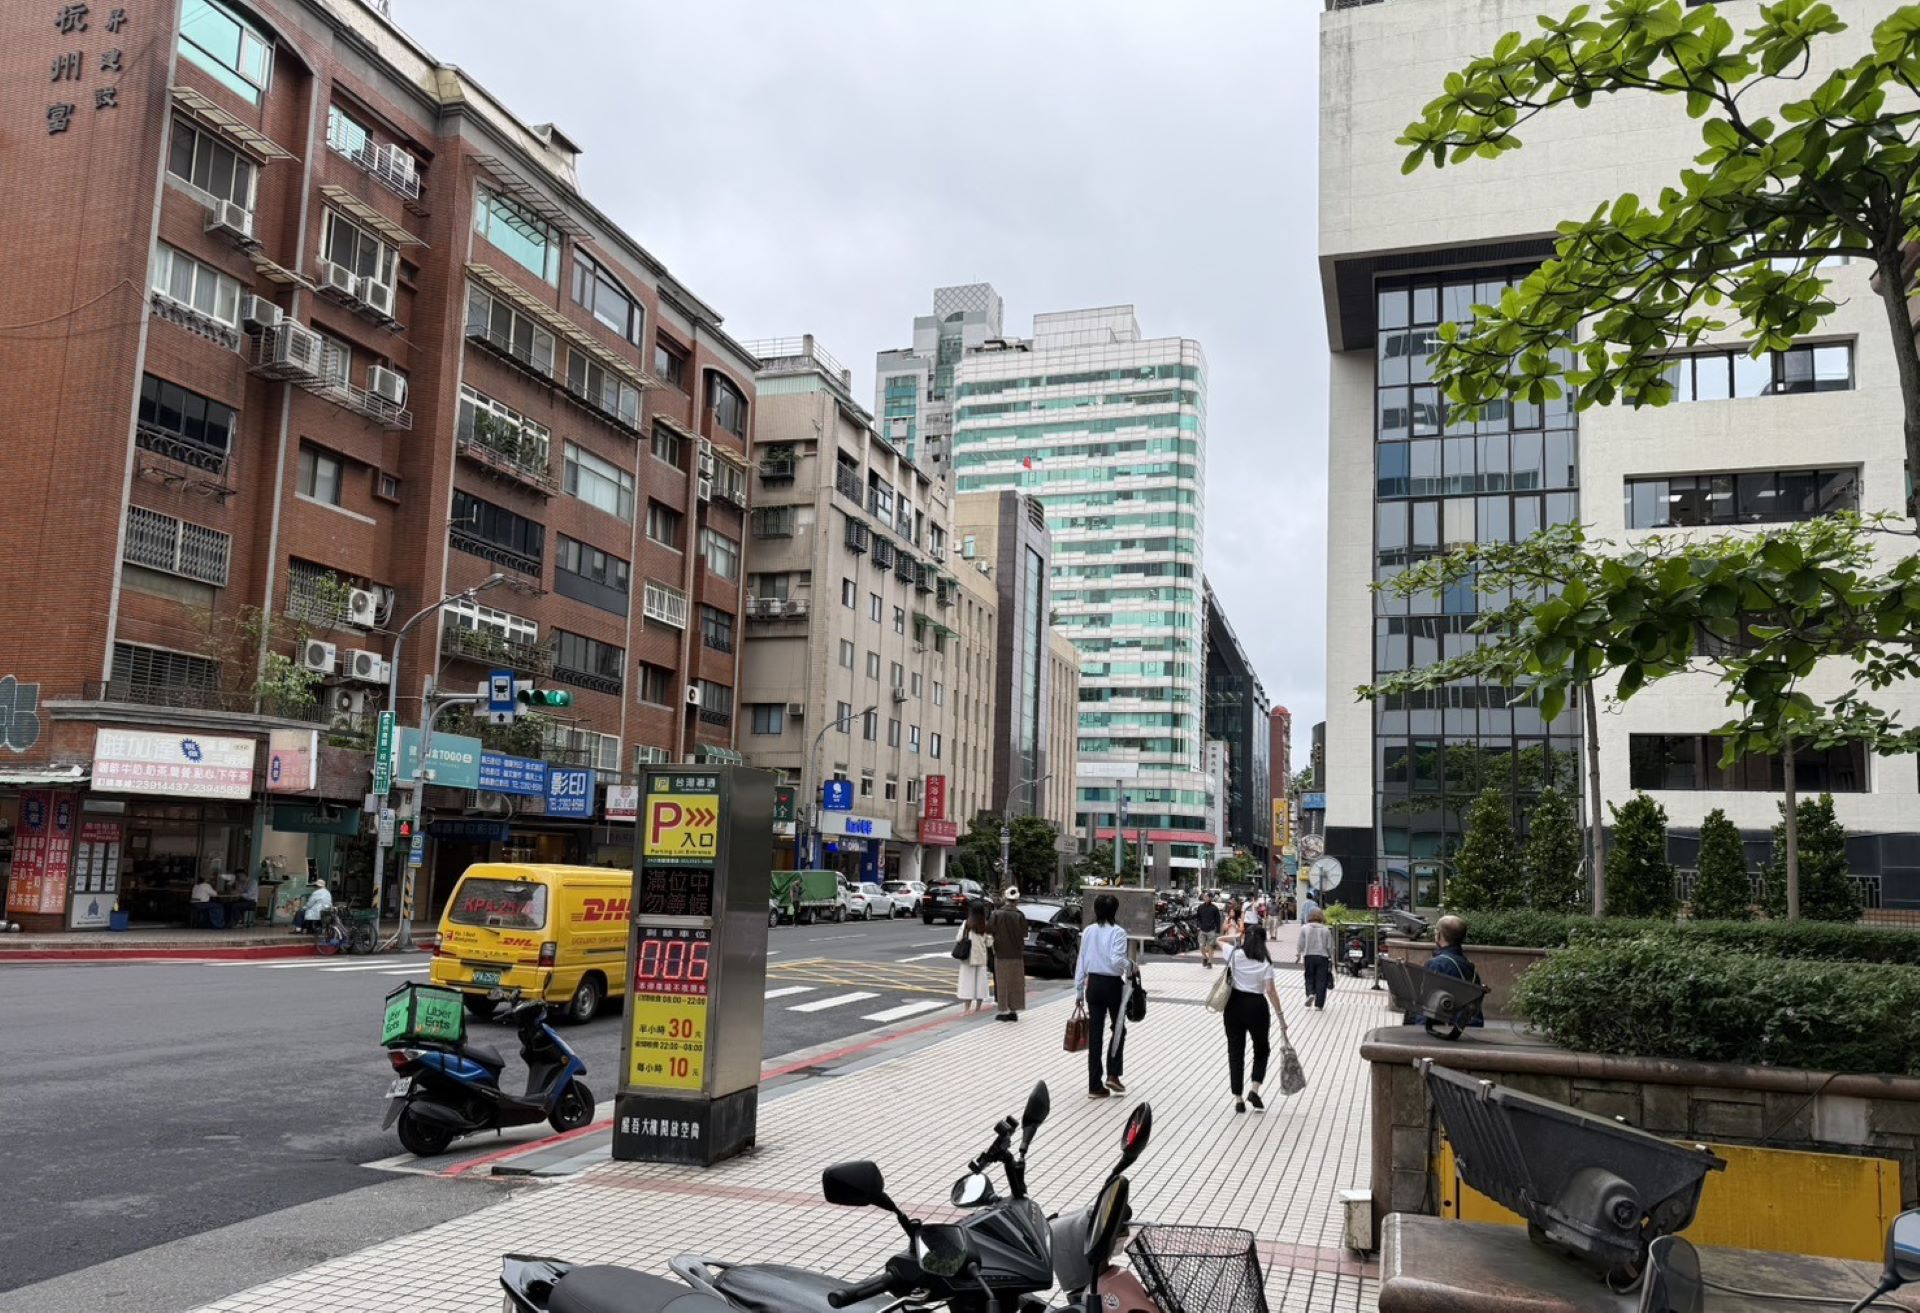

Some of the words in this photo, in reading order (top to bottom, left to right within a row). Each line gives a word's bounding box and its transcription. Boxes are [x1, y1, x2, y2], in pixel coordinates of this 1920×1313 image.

[551, 771, 587, 796] 影印
[651, 801, 683, 844] P
[680, 832, 714, 848] 入口
[650, 848, 673, 856] Parking
[646, 869, 710, 893] 滿位中
[583, 898, 631, 921] DH
[646, 893, 709, 915] 勿等候
[502, 937, 535, 947] DHL
[645, 928, 706, 939] 剩餘車位
[638, 940, 711, 981] 006
[387, 1010, 401, 1023] Uber
[426, 1005, 453, 1019] Uber
[386, 1020, 400, 1034] Eats
[425, 1016, 451, 1030] Eats
[639, 1024, 666, 1036] 半小時
[668, 1018, 693, 1039] 30
[636, 1062, 663, 1073] 每小時
[669, 1057, 689, 1078] 10
